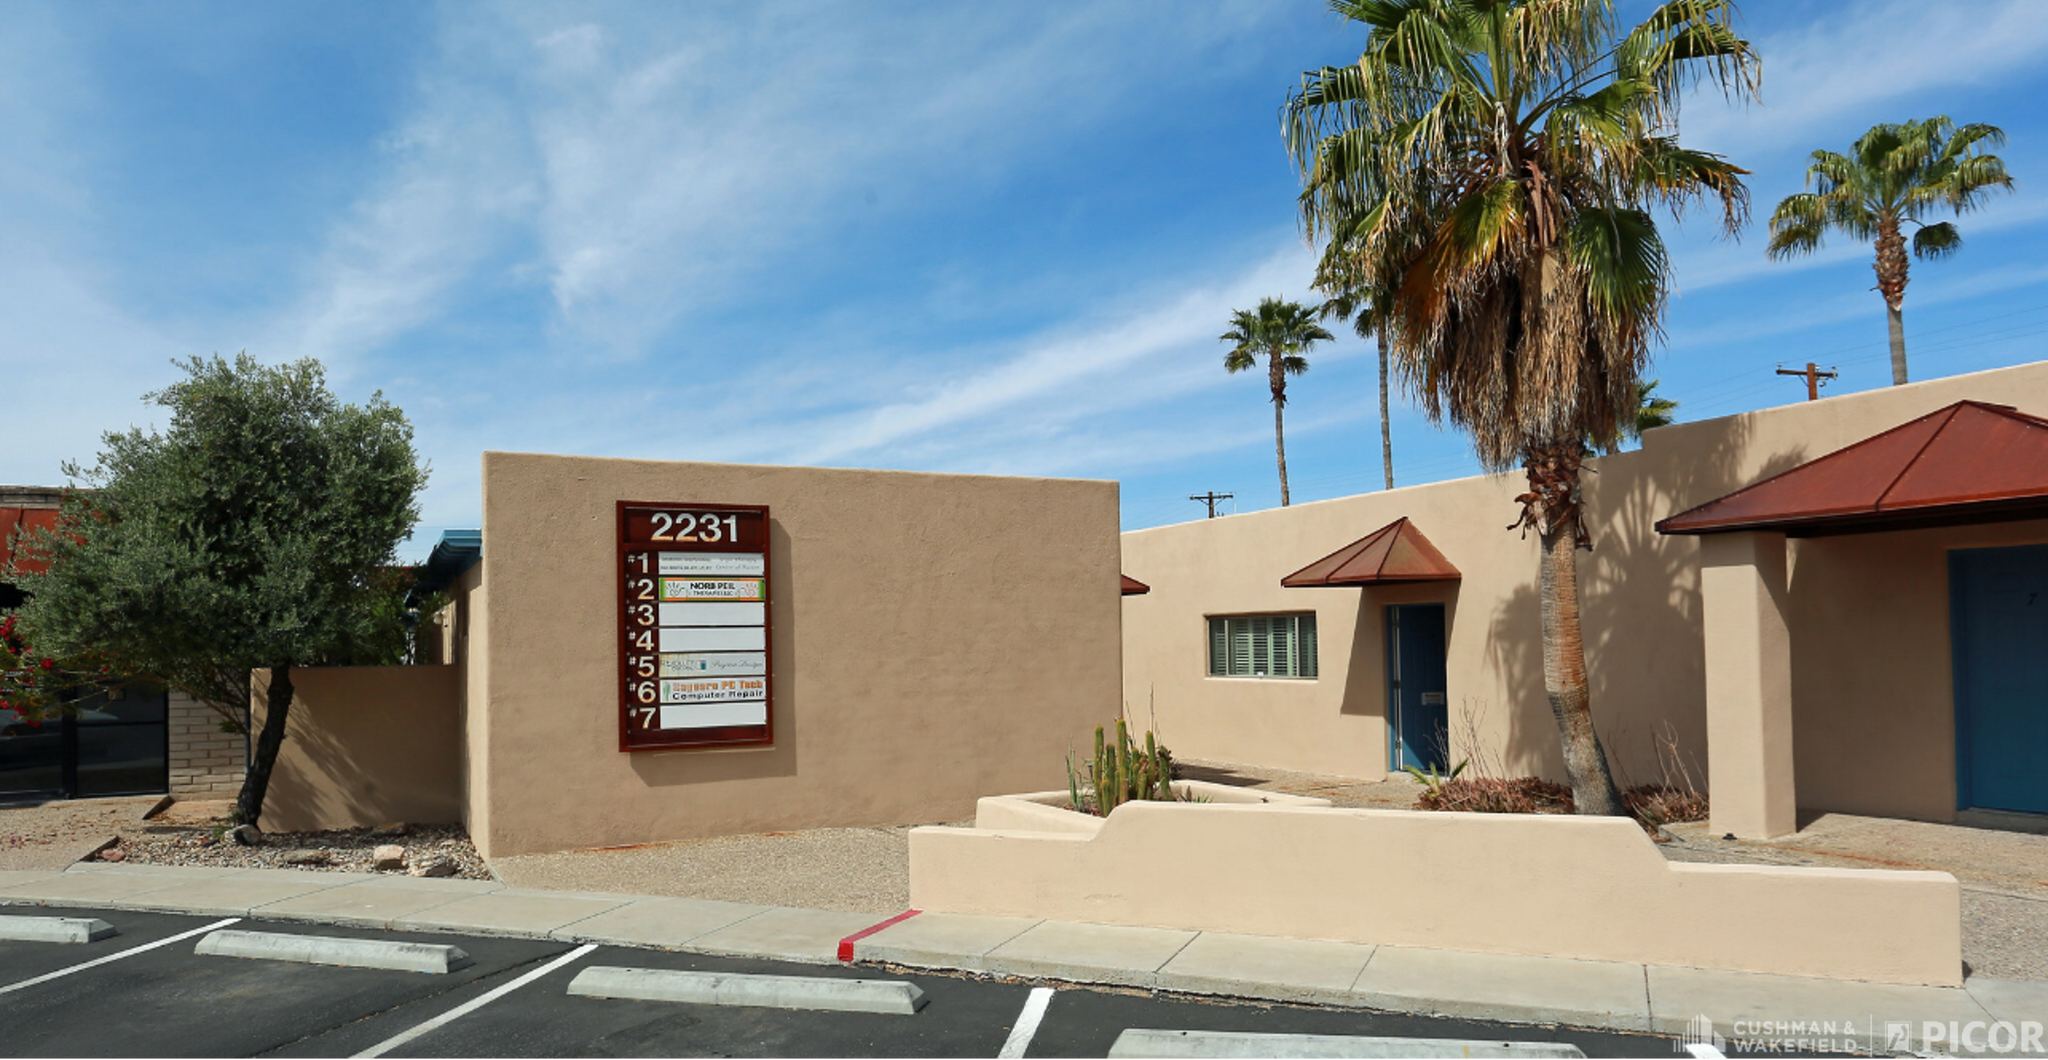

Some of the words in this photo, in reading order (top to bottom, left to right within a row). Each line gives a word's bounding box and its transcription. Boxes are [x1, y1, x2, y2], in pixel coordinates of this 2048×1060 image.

[650, 512, 738, 543] 2231
[628, 552, 650, 574] #1
[628, 577, 655, 600] #2
[690, 582, 716, 590] NORB
[2028, 592, 2039, 605] 7
[628, 603, 655, 626] #3
[628, 629, 655, 652] #4
[628, 655, 655, 678] #5
[628, 680, 657, 703] #6
[672, 692, 725, 700] Computer
[729, 690, 763, 698] Repair
[673, 682, 718, 692] Saguaro
[721, 680, 736, 690] PC
[739, 680, 763, 689] Tech
[628, 706, 657, 729] #7
